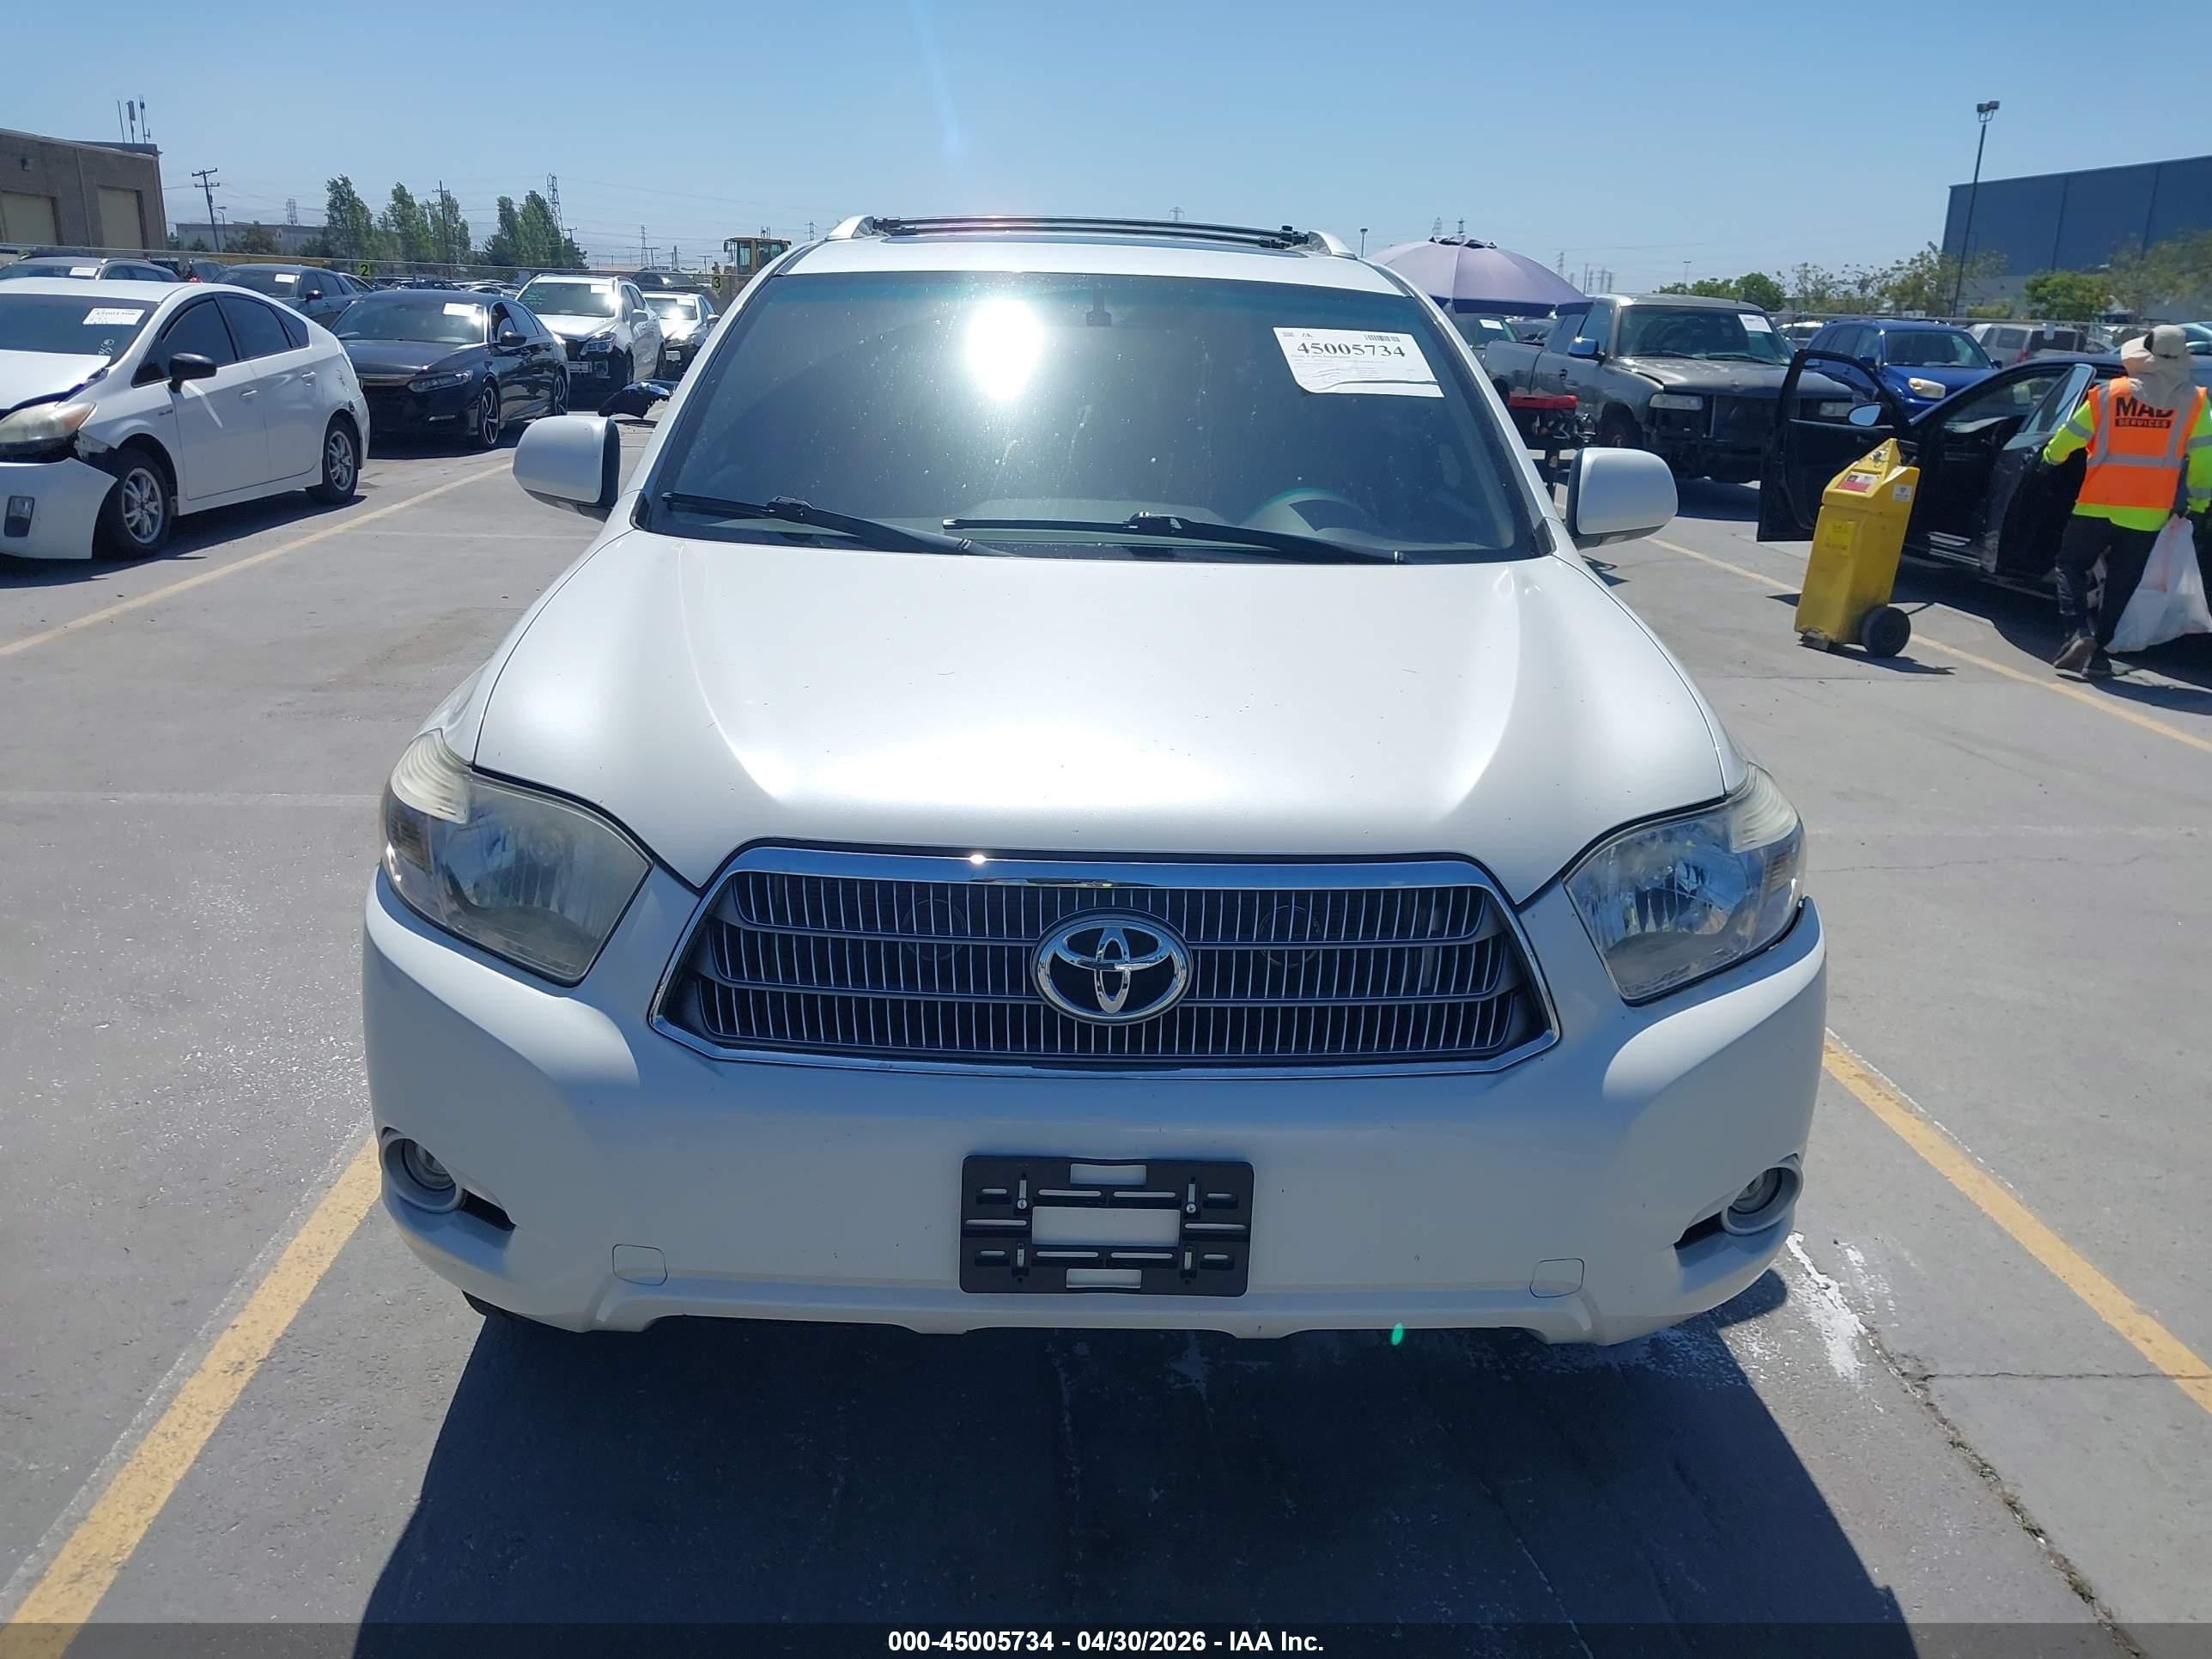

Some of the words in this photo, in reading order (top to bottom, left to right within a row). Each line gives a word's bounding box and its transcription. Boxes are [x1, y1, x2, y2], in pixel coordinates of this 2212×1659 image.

[360, 264, 369, 276] 2
[713, 276, 721, 289] 3
[1297, 342, 1406, 358] 45005734
[2118, 417, 2169, 428] SERVICES
